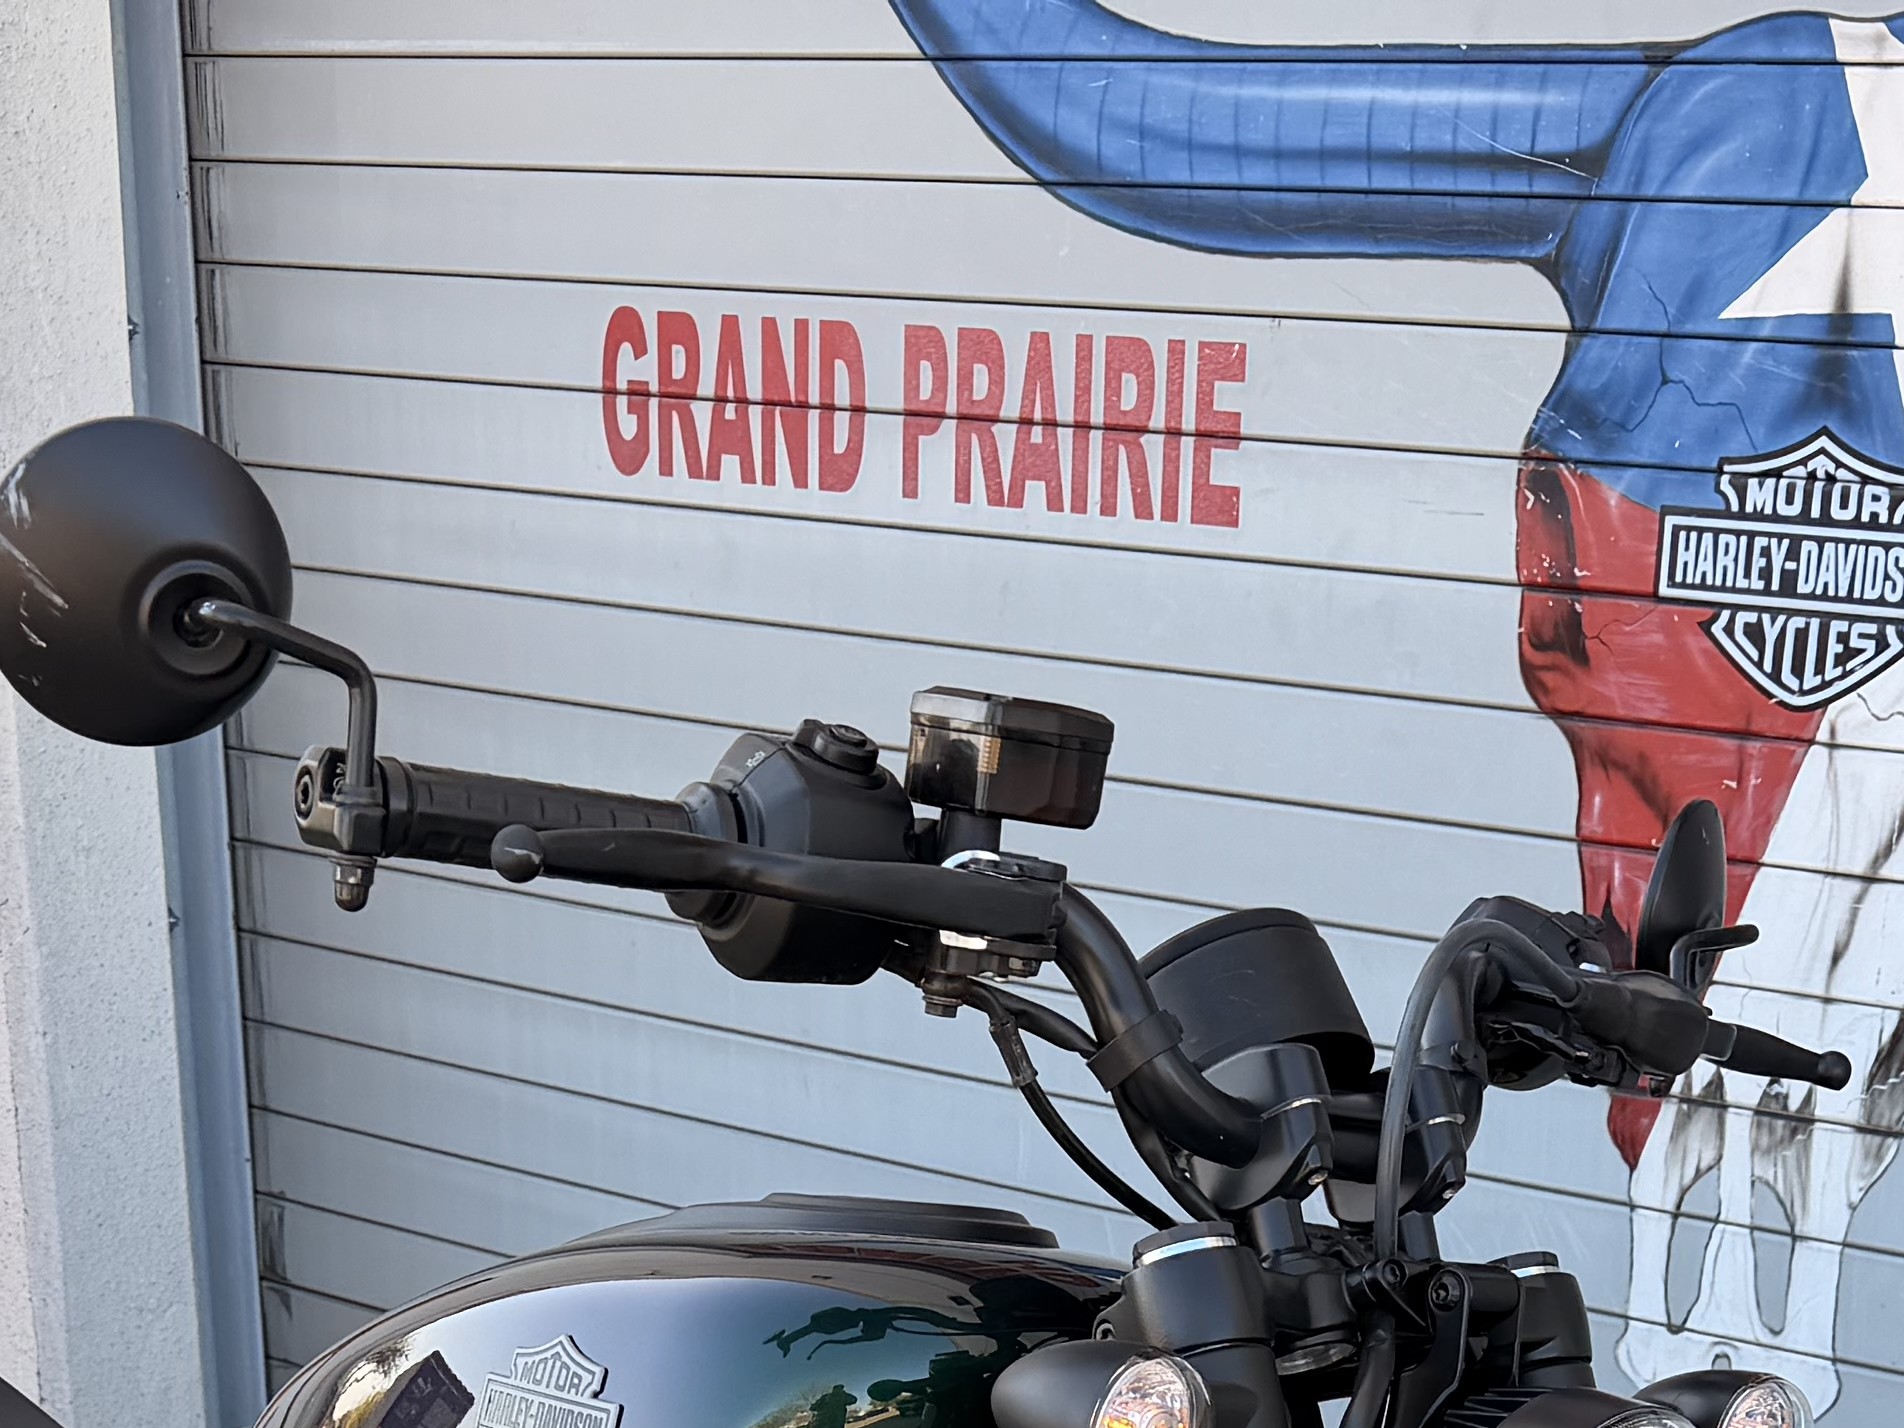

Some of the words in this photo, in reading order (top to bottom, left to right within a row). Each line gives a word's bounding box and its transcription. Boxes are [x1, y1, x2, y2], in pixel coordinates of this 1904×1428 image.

[601, 305, 866, 493] GRAND
[902, 324, 1248, 529] PRAIRIE
[1746, 454, 1891, 524] MOTOR
[1734, 611, 1878, 691] CYCLES
[519, 1351, 583, 1397] MOTOR
